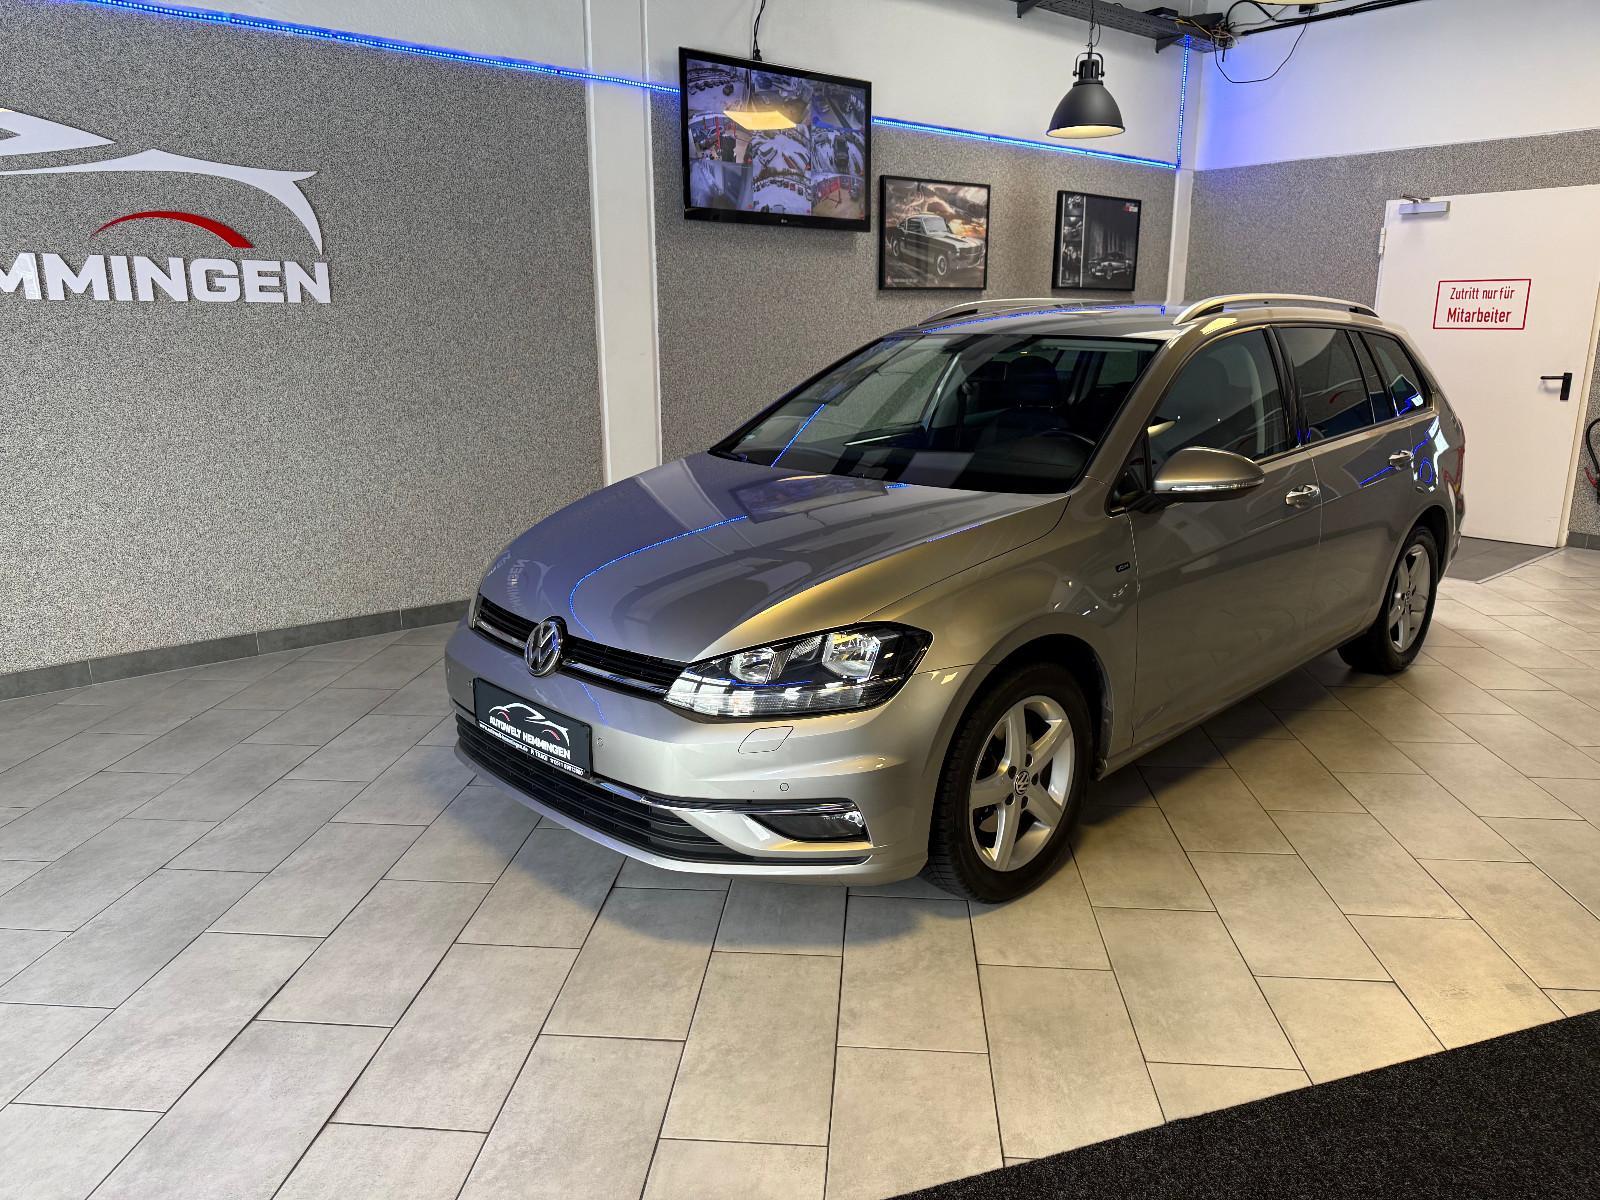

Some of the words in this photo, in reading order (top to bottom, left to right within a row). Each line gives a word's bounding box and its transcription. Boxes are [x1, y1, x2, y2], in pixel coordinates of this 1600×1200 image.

[1450, 287, 1480, 300] Zutritt
[1482, 289, 1499, 300] nur
[1499, 286, 1516, 301] für
[1447, 307, 1512, 323] Mitarbeiter
[489, 715, 522, 739] AUTOWELT
[522, 732, 571, 761] HEMMINGEN
